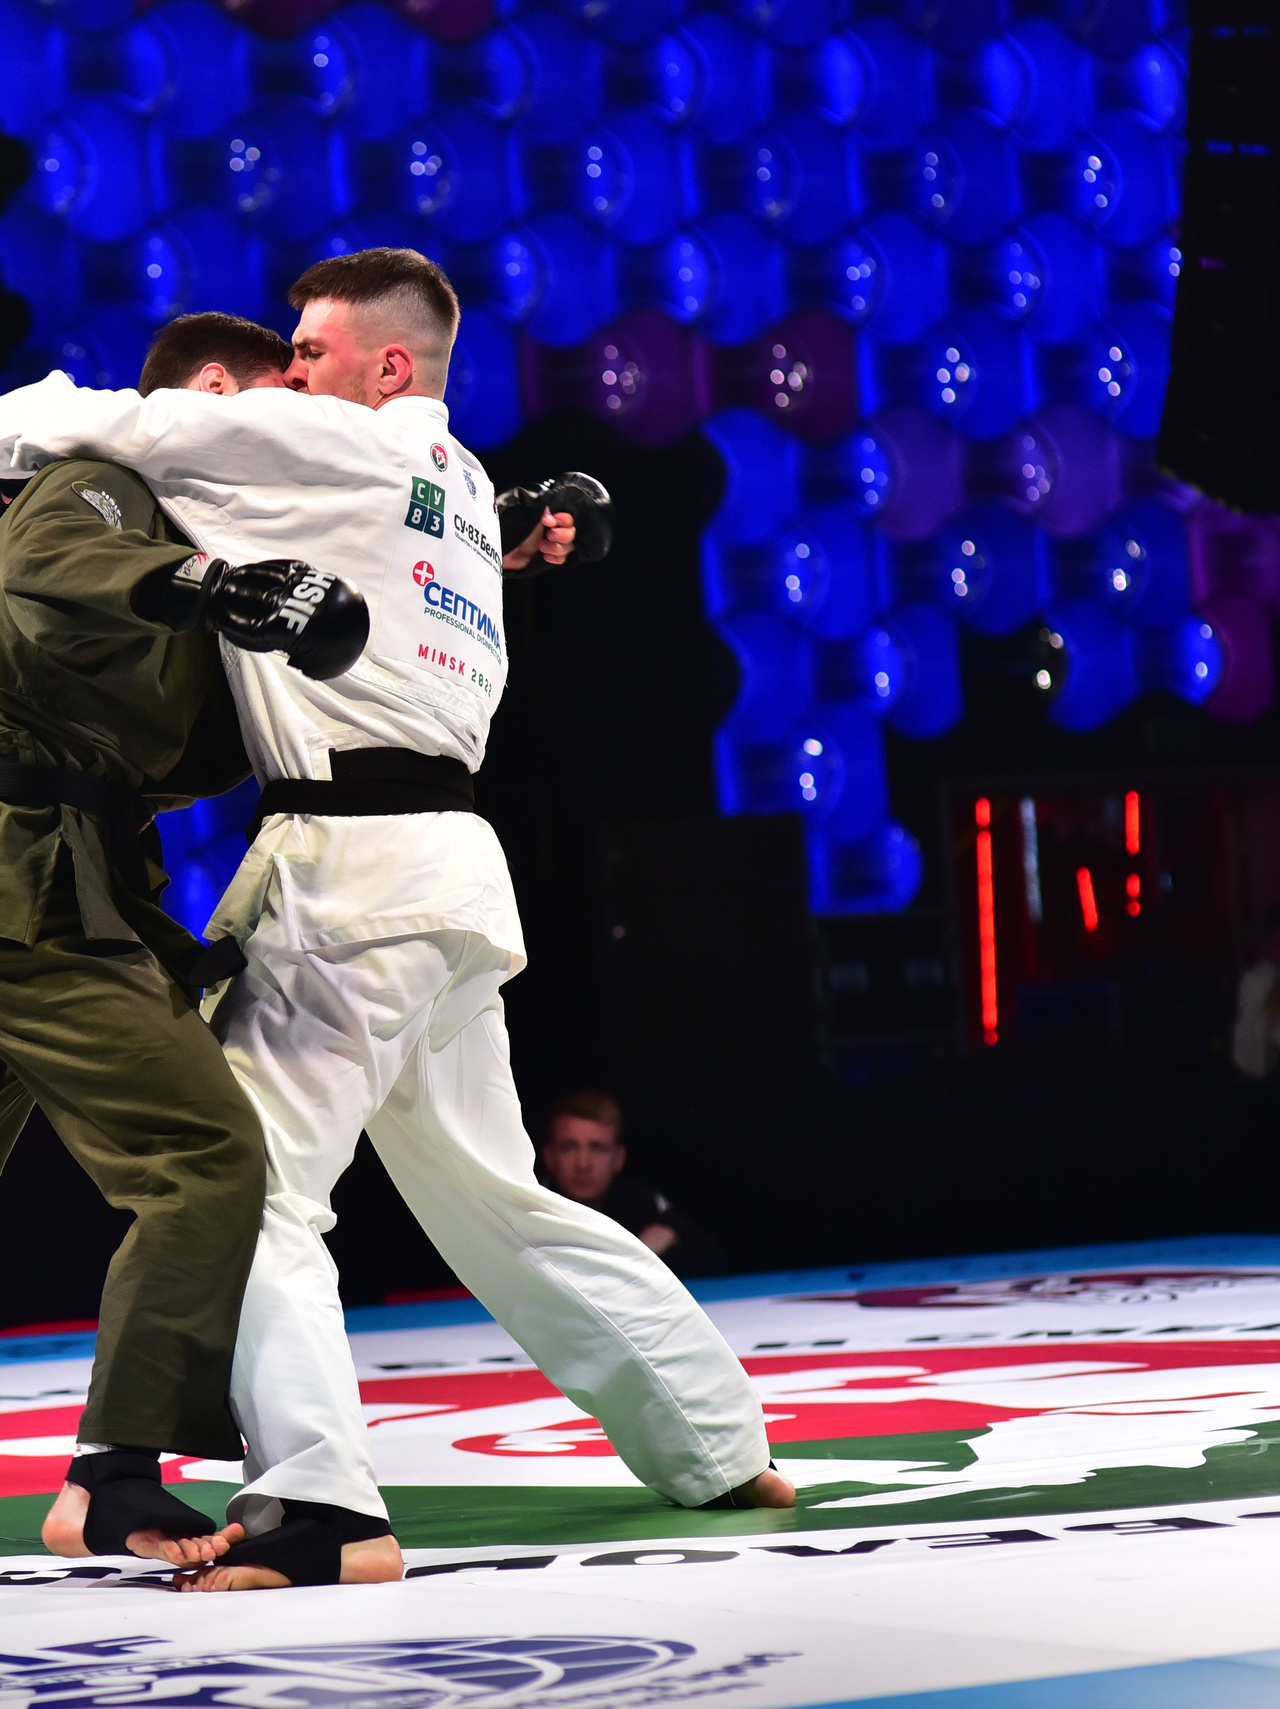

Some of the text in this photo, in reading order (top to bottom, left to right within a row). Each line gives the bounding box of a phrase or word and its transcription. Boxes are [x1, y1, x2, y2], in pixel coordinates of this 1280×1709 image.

[411, 507, 441, 532] 83
[279, 569, 337, 635] HSIF
[424, 607, 476, 639] PROFESSIONAL
[418, 643, 493, 698] MINSK 2022
